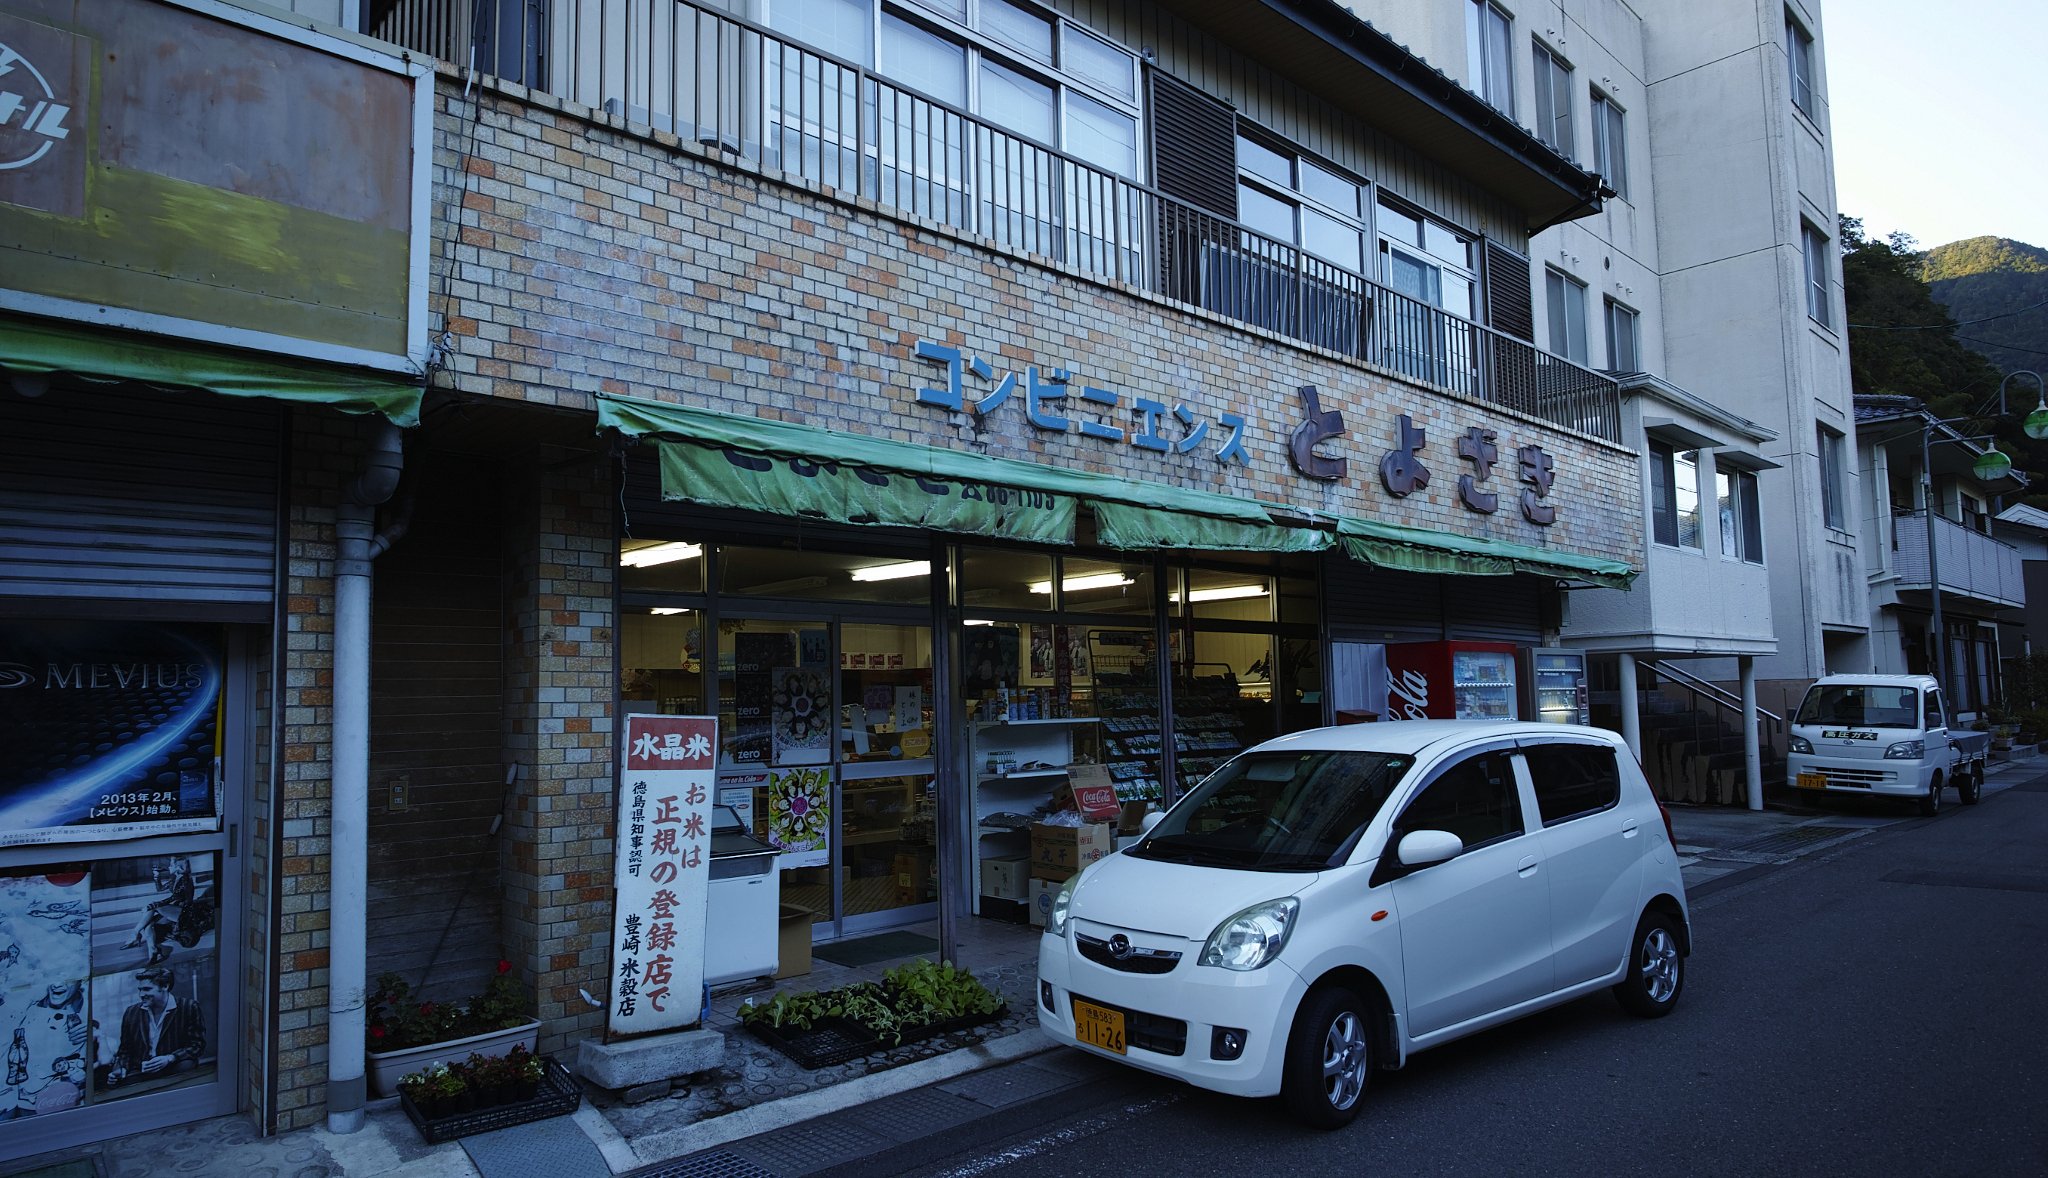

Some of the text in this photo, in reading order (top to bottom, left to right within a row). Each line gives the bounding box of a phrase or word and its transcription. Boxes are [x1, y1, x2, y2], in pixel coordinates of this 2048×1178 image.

[915, 340, 1558, 527] コンビニエンス とよざき
[45, 663, 204, 690] MEVIUS
[737, 663, 759, 672] zero
[737, 706, 760, 716] zero
[631, 733, 712, 761] 水晶米
[1825, 731, 1875, 740] 高圧ガス
[738, 750, 760, 759] zero
[628, 781, 647, 877] 徳島県知事認可
[681, 782, 706, 869] お米は
[641, 795, 682, 1012] 正規の登録店で
[1100, 1011, 1112, 1024] 583
[1087, 1020, 1123, 1051] 11-26
